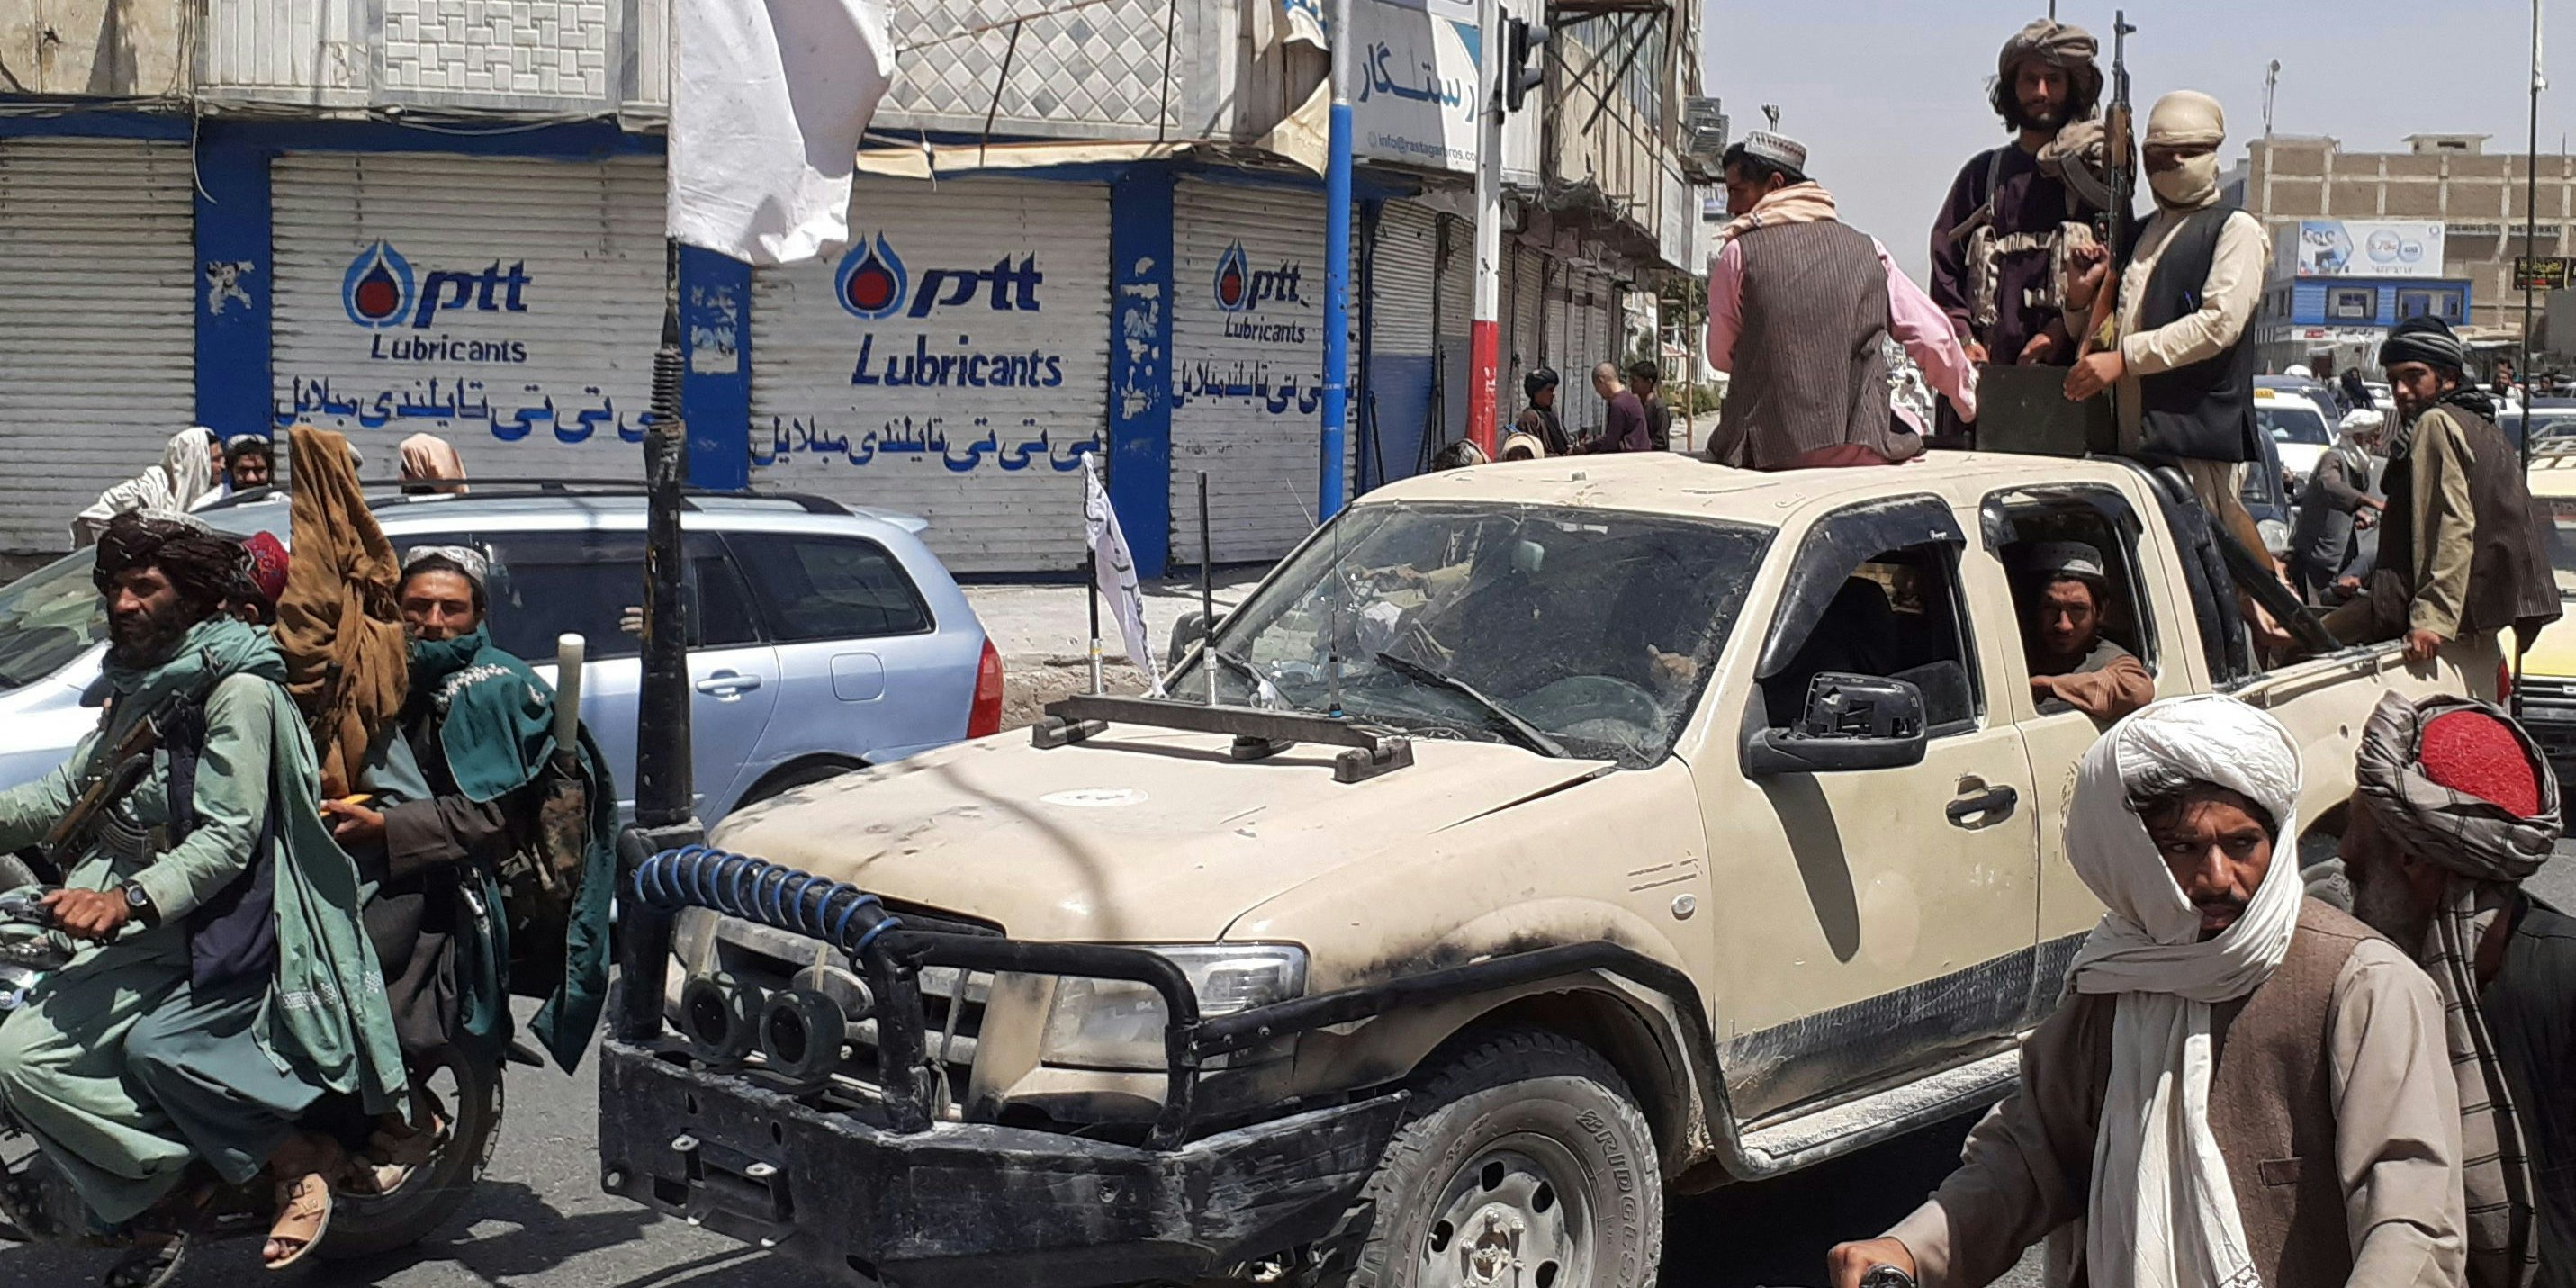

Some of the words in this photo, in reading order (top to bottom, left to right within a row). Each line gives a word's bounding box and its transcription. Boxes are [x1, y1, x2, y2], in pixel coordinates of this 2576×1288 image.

[1358, 41, 1475, 122] رستگار
[1379, 133, 1477, 161] info@rastagarbros.co
[412, 258, 532, 329] ptt
[906, 249, 1043, 319] ptt
[1246, 259, 1301, 310] ptt
[371, 333, 527, 363] Lubricants
[1224, 314, 1306, 344] Lubricants
[851, 334, 1064, 388] Lubricants
[1576, 1108, 1637, 1288] BRIDGES
